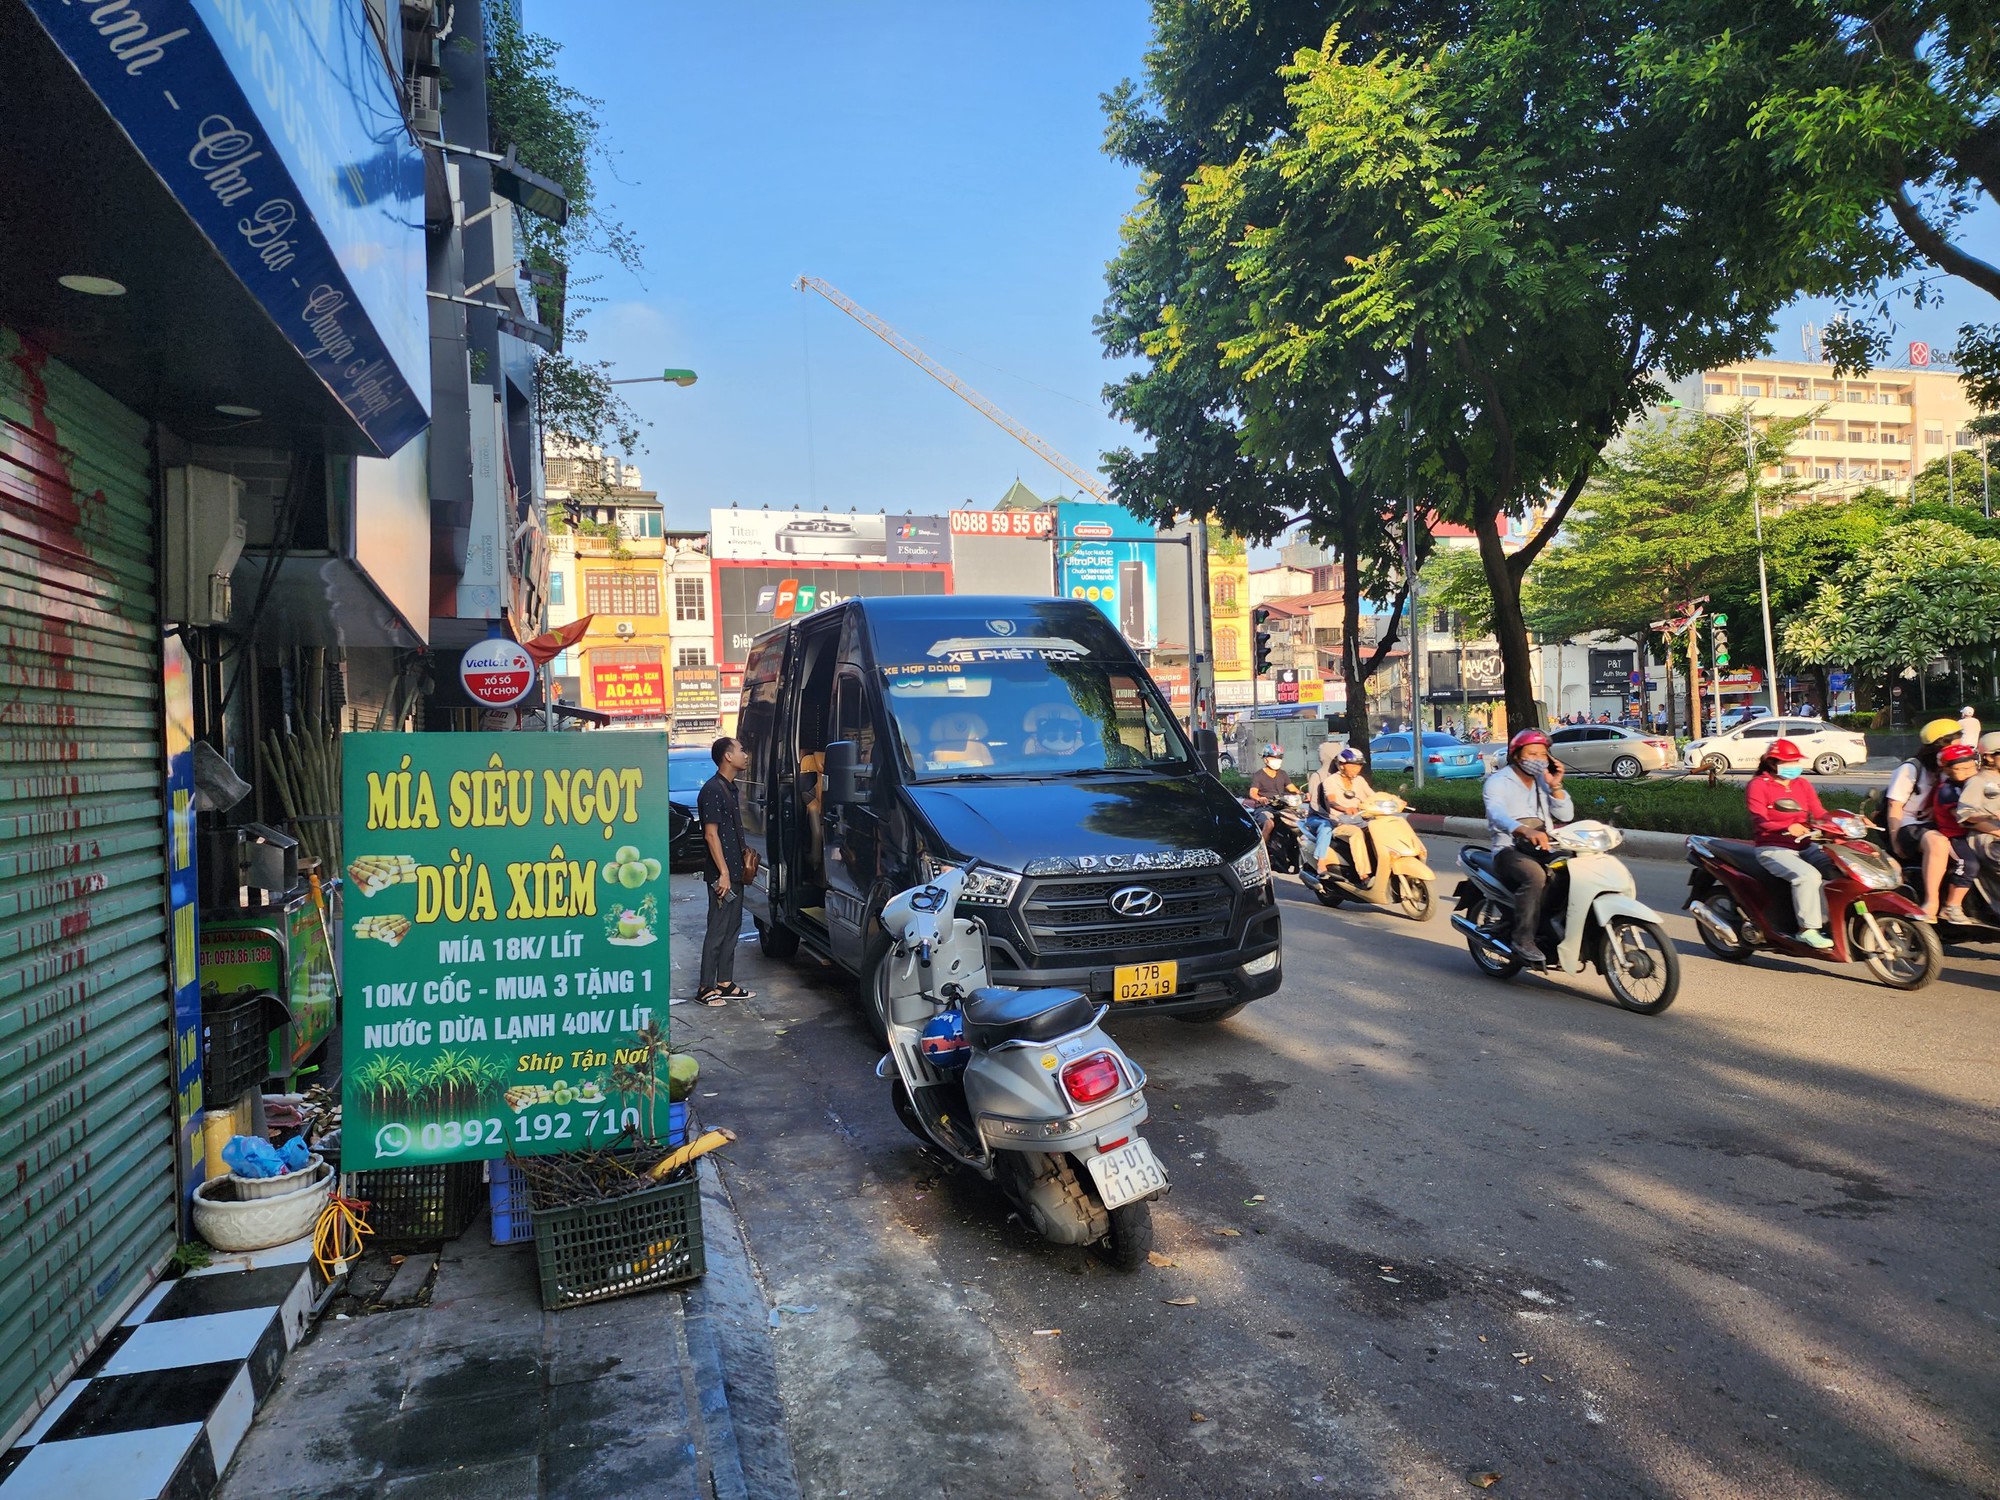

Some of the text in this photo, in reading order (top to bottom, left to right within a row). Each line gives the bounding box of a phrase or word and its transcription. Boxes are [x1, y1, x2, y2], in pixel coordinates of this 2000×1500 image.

[188, 114, 263, 207] Chu
[238, 198, 302, 273] Đáo
[952, 512, 1051, 533] 0988 59 55 66
[884, 666, 899, 675] XE
[902, 664, 925, 675] HỢP
[947, 651, 975, 663] XE
[1039, 650, 1080, 662] HỌC
[1607, 660, 1621, 668] P&T
[479, 687, 519, 697] TỰ CHỌN
[366, 752, 643, 840] MÍA SIÊU NGỌT
[414, 844, 598, 924] DỪA XIÊM
[439, 934, 584, 964] MÍA 18K/ LÍT
[362, 984, 418, 1009] 10K/
[423, 971, 471, 1004] CỐC
[496, 975, 547, 1001] MUA
[553, 974, 568, 997] 3
[575, 966, 634, 1002] TẶNG
[642, 970, 652, 991] 1
[1134, 965, 1160, 980] 17B
[1121, 979, 1170, 998] 022.19
[364, 1007, 652, 1050] NƯỚC DỪA LẠNH 40K/ LÍT
[517, 1045, 650, 1074] Ship Tận Nơi
[421, 1106, 640, 1150] 0392 192 710
[1099, 1146, 1146, 1180] 29-D1
[1104, 1166, 1160, 1203] 411.33
